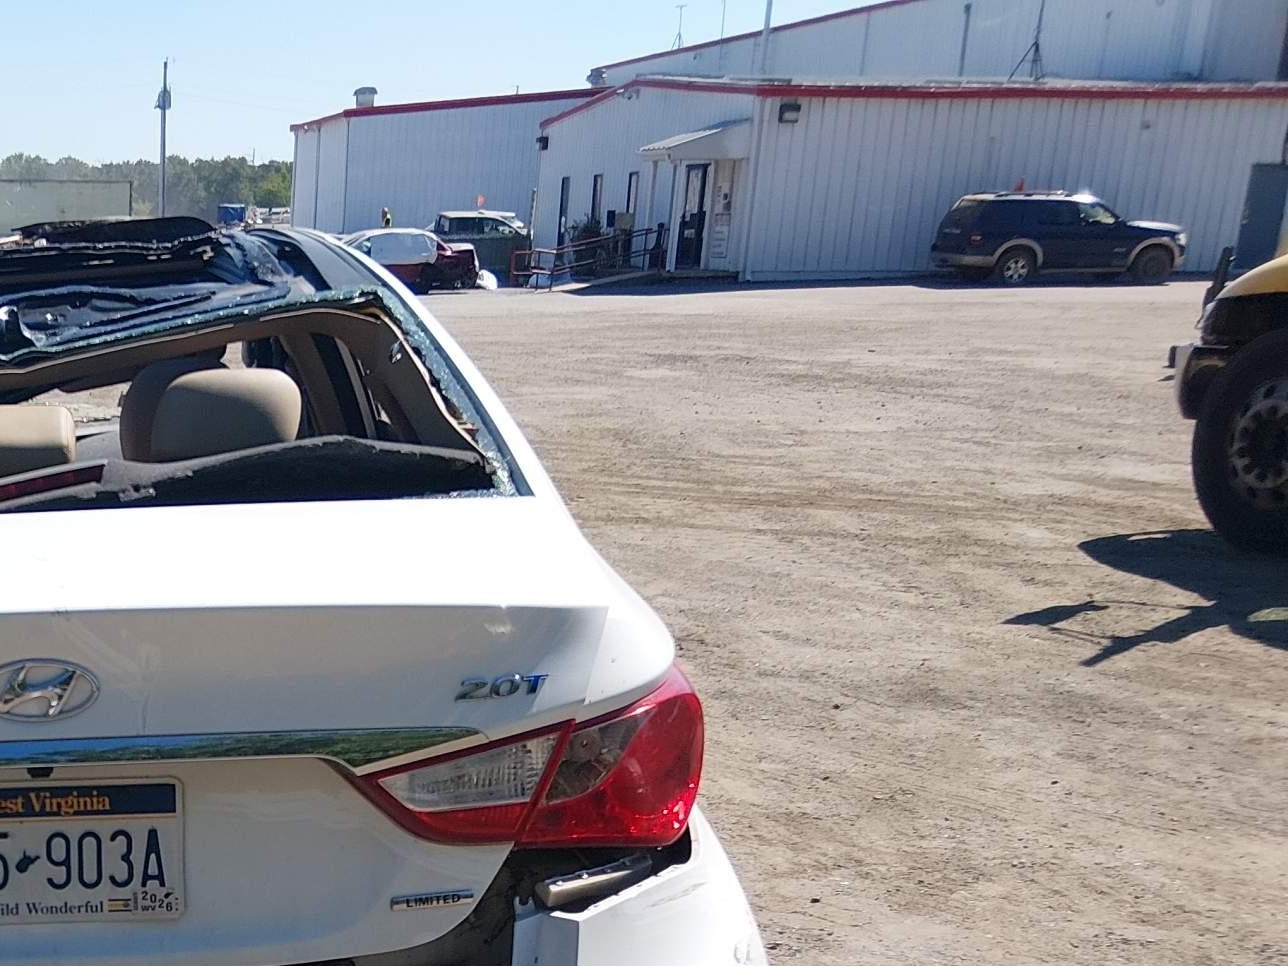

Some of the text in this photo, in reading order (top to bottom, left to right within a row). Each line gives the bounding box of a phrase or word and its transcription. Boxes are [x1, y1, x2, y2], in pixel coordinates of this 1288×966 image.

[29, 790, 111, 816] Virginia
[26, 900, 104, 916] Wonderful
[405, 893, 461, 908] LIMITED
